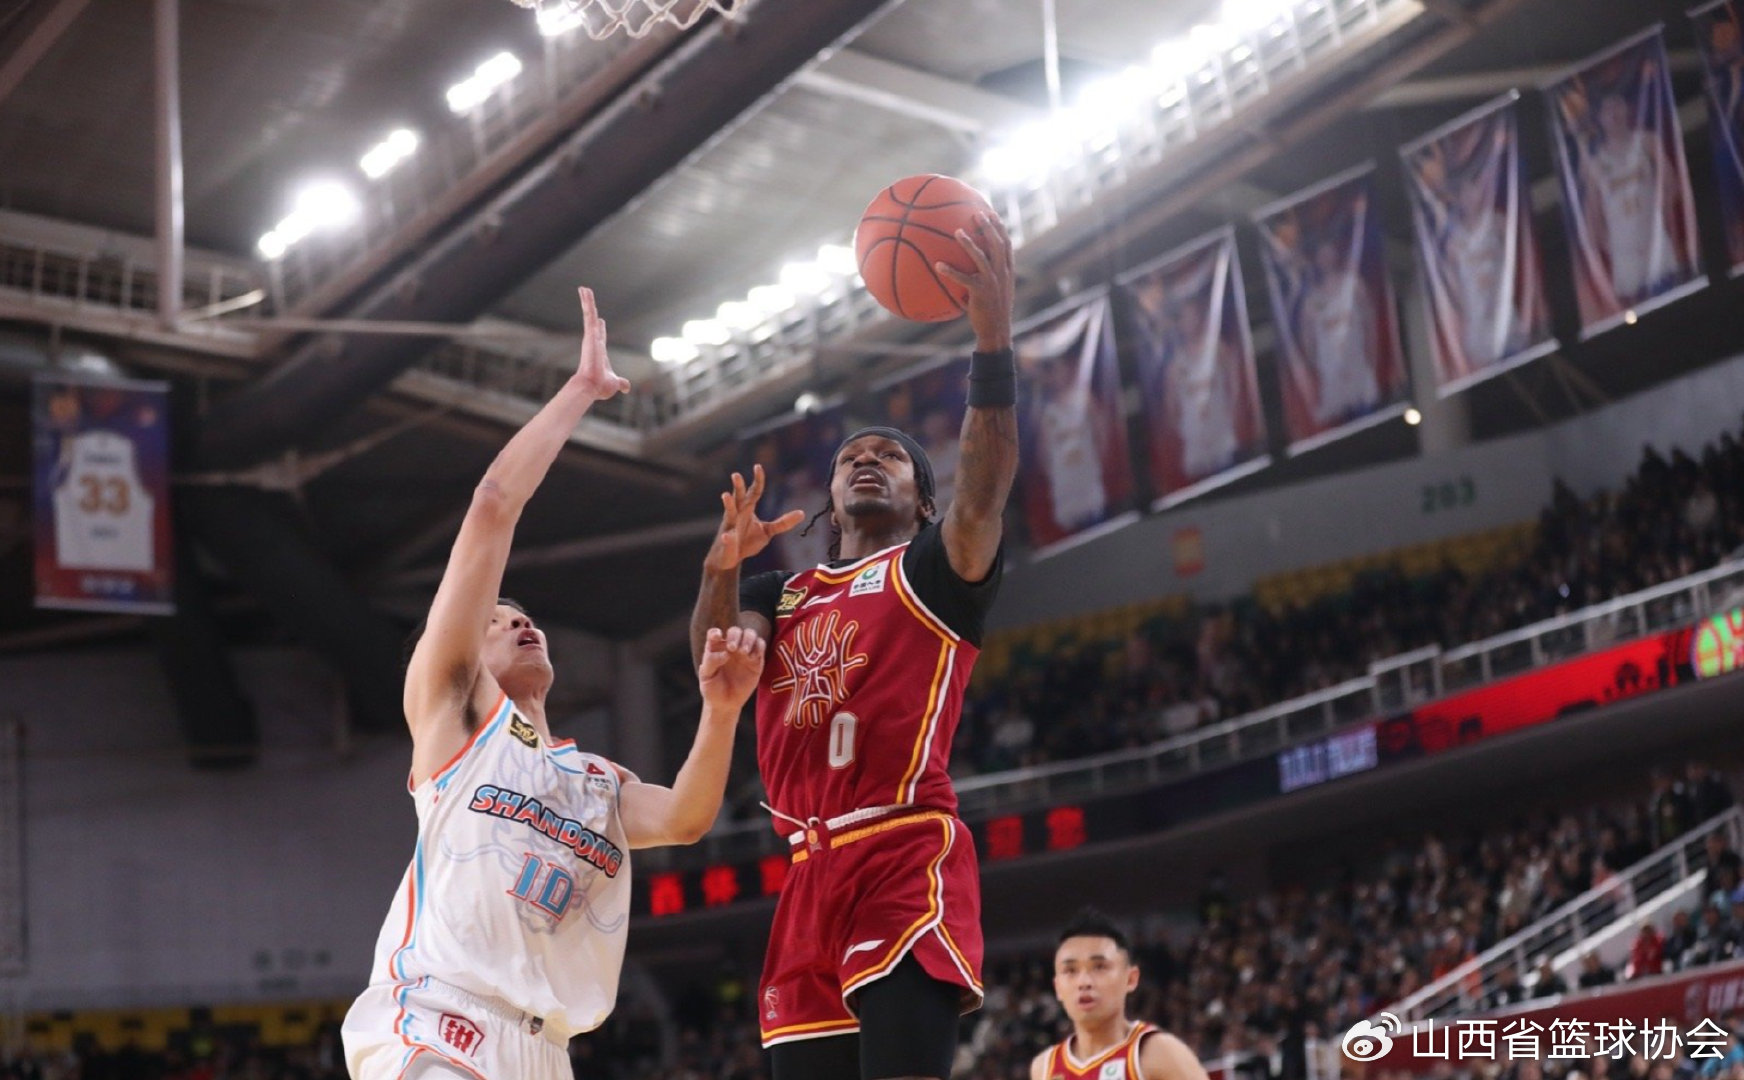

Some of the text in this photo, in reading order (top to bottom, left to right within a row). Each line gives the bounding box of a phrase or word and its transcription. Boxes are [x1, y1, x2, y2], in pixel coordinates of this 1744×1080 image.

[79, 474, 130, 516] 33
[828, 711, 859, 770] 0
[468, 784, 624, 879] SHANDONG
[507, 852, 575, 921] 10
